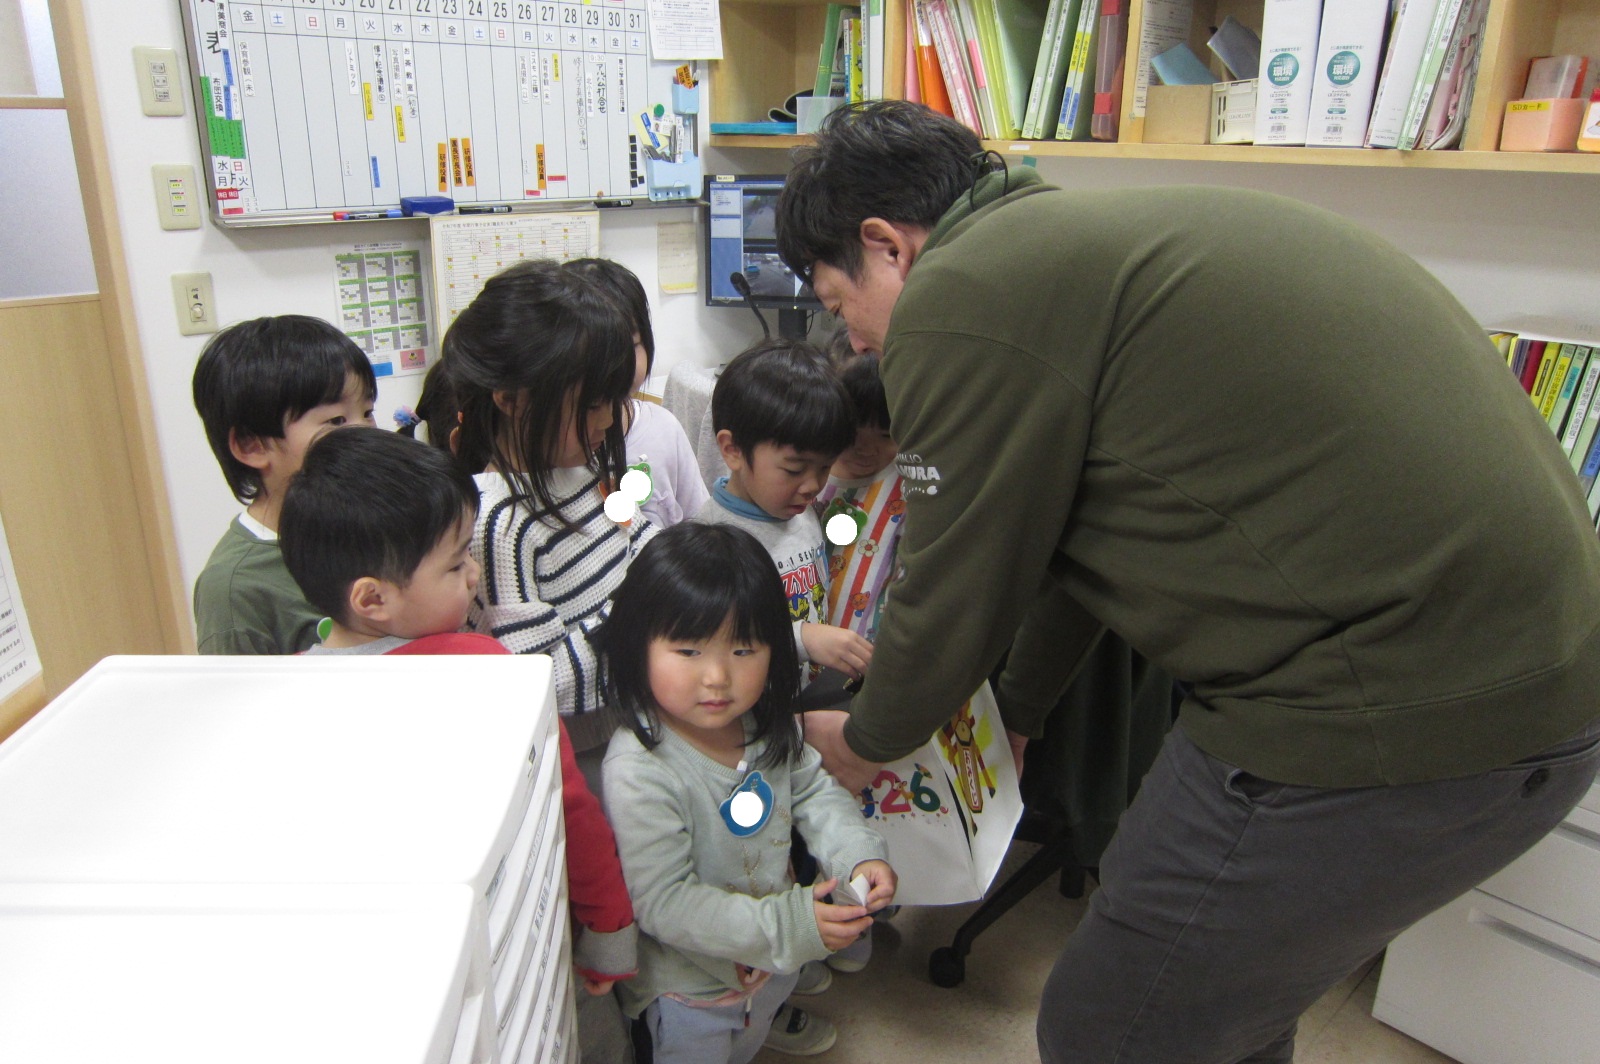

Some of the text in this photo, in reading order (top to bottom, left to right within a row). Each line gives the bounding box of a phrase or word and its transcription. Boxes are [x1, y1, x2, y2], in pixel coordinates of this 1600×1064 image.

[416, 0, 431, 12] 22
[443, 0, 457, 14] 23
[469, 0, 482, 16] 24
[494, 1, 507, 18] 25
[518, 4, 531, 20] 26
[541, 6, 554, 22] 27
[564, 8, 577, 24] 28
[586, 10, 598, 26] 29
[608, 12, 620, 27] 30
[629, 14, 640, 28] 31
[243, 10, 640, 48] 金 土 日 月 火 水 木 金 土 日 月 火 水 木 金 土
[590, 54, 605, 62] 9:30
[347, 48, 356, 88] リトミック
[1273, 66, 1293, 77] 環境
[1332, 65, 1354, 75] 環境
[218, 161, 228, 170] 水
[234, 162, 243, 171] 日
[218, 176, 227, 186] 月
[239, 177, 248, 186] 火
